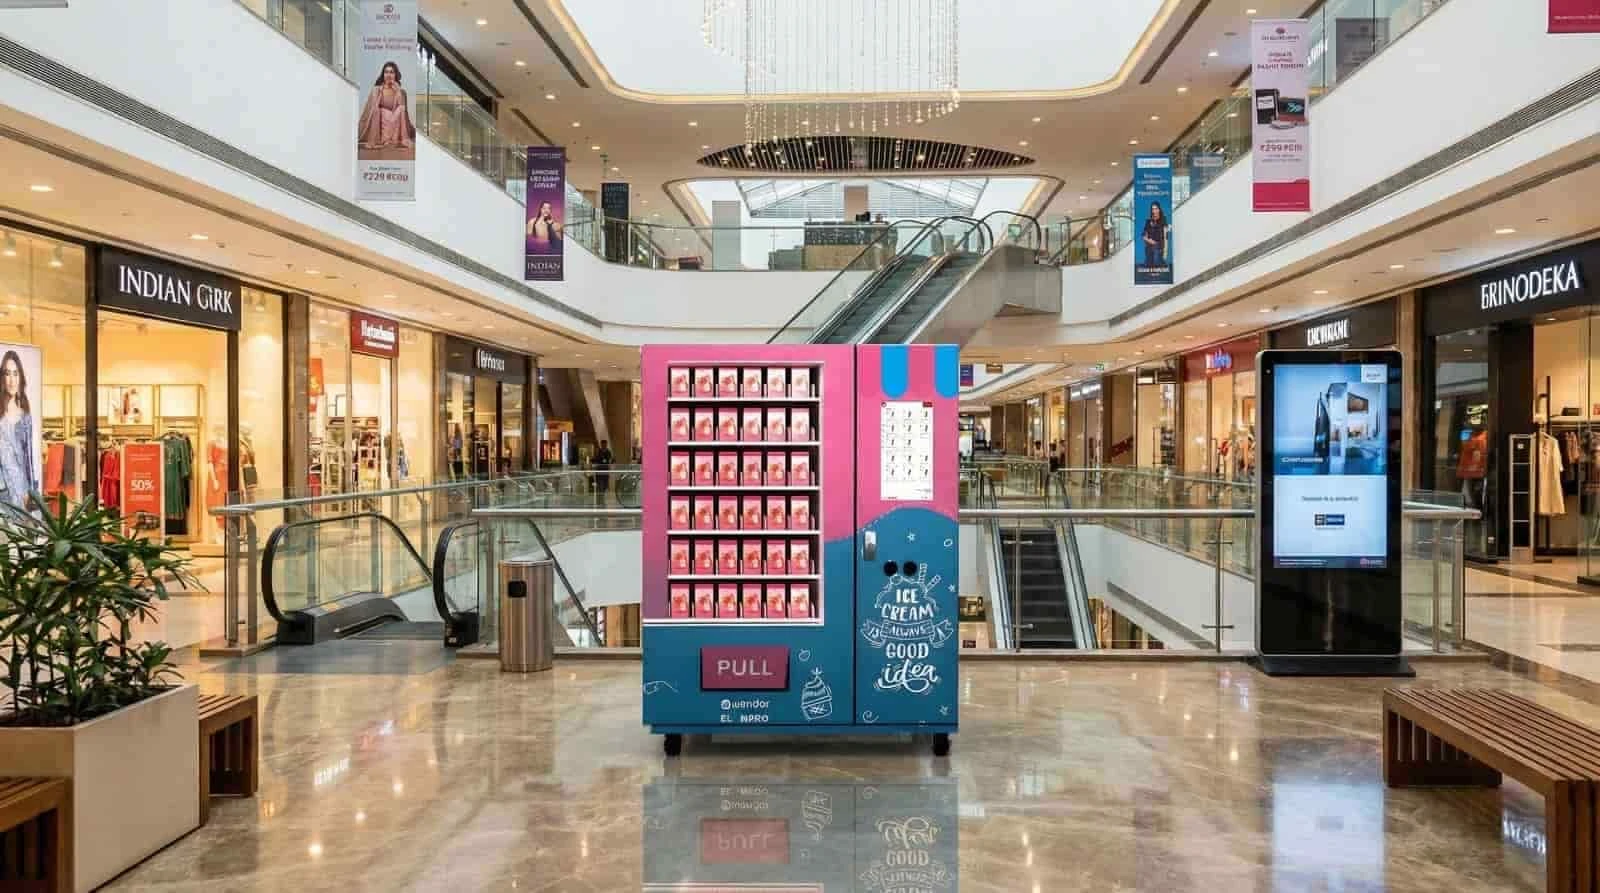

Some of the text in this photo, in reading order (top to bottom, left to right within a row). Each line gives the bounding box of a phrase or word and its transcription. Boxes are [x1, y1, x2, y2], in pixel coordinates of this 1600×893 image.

[119, 265, 191, 306] INDIAN
[896, 588, 920, 604] ICE
[881, 603, 934, 621] CREAM
[889, 624, 927, 638] ALWAYS
[885, 642, 930, 660] GOOD
[717, 659, 774, 677] PULL
[877, 658, 939, 694] idea
